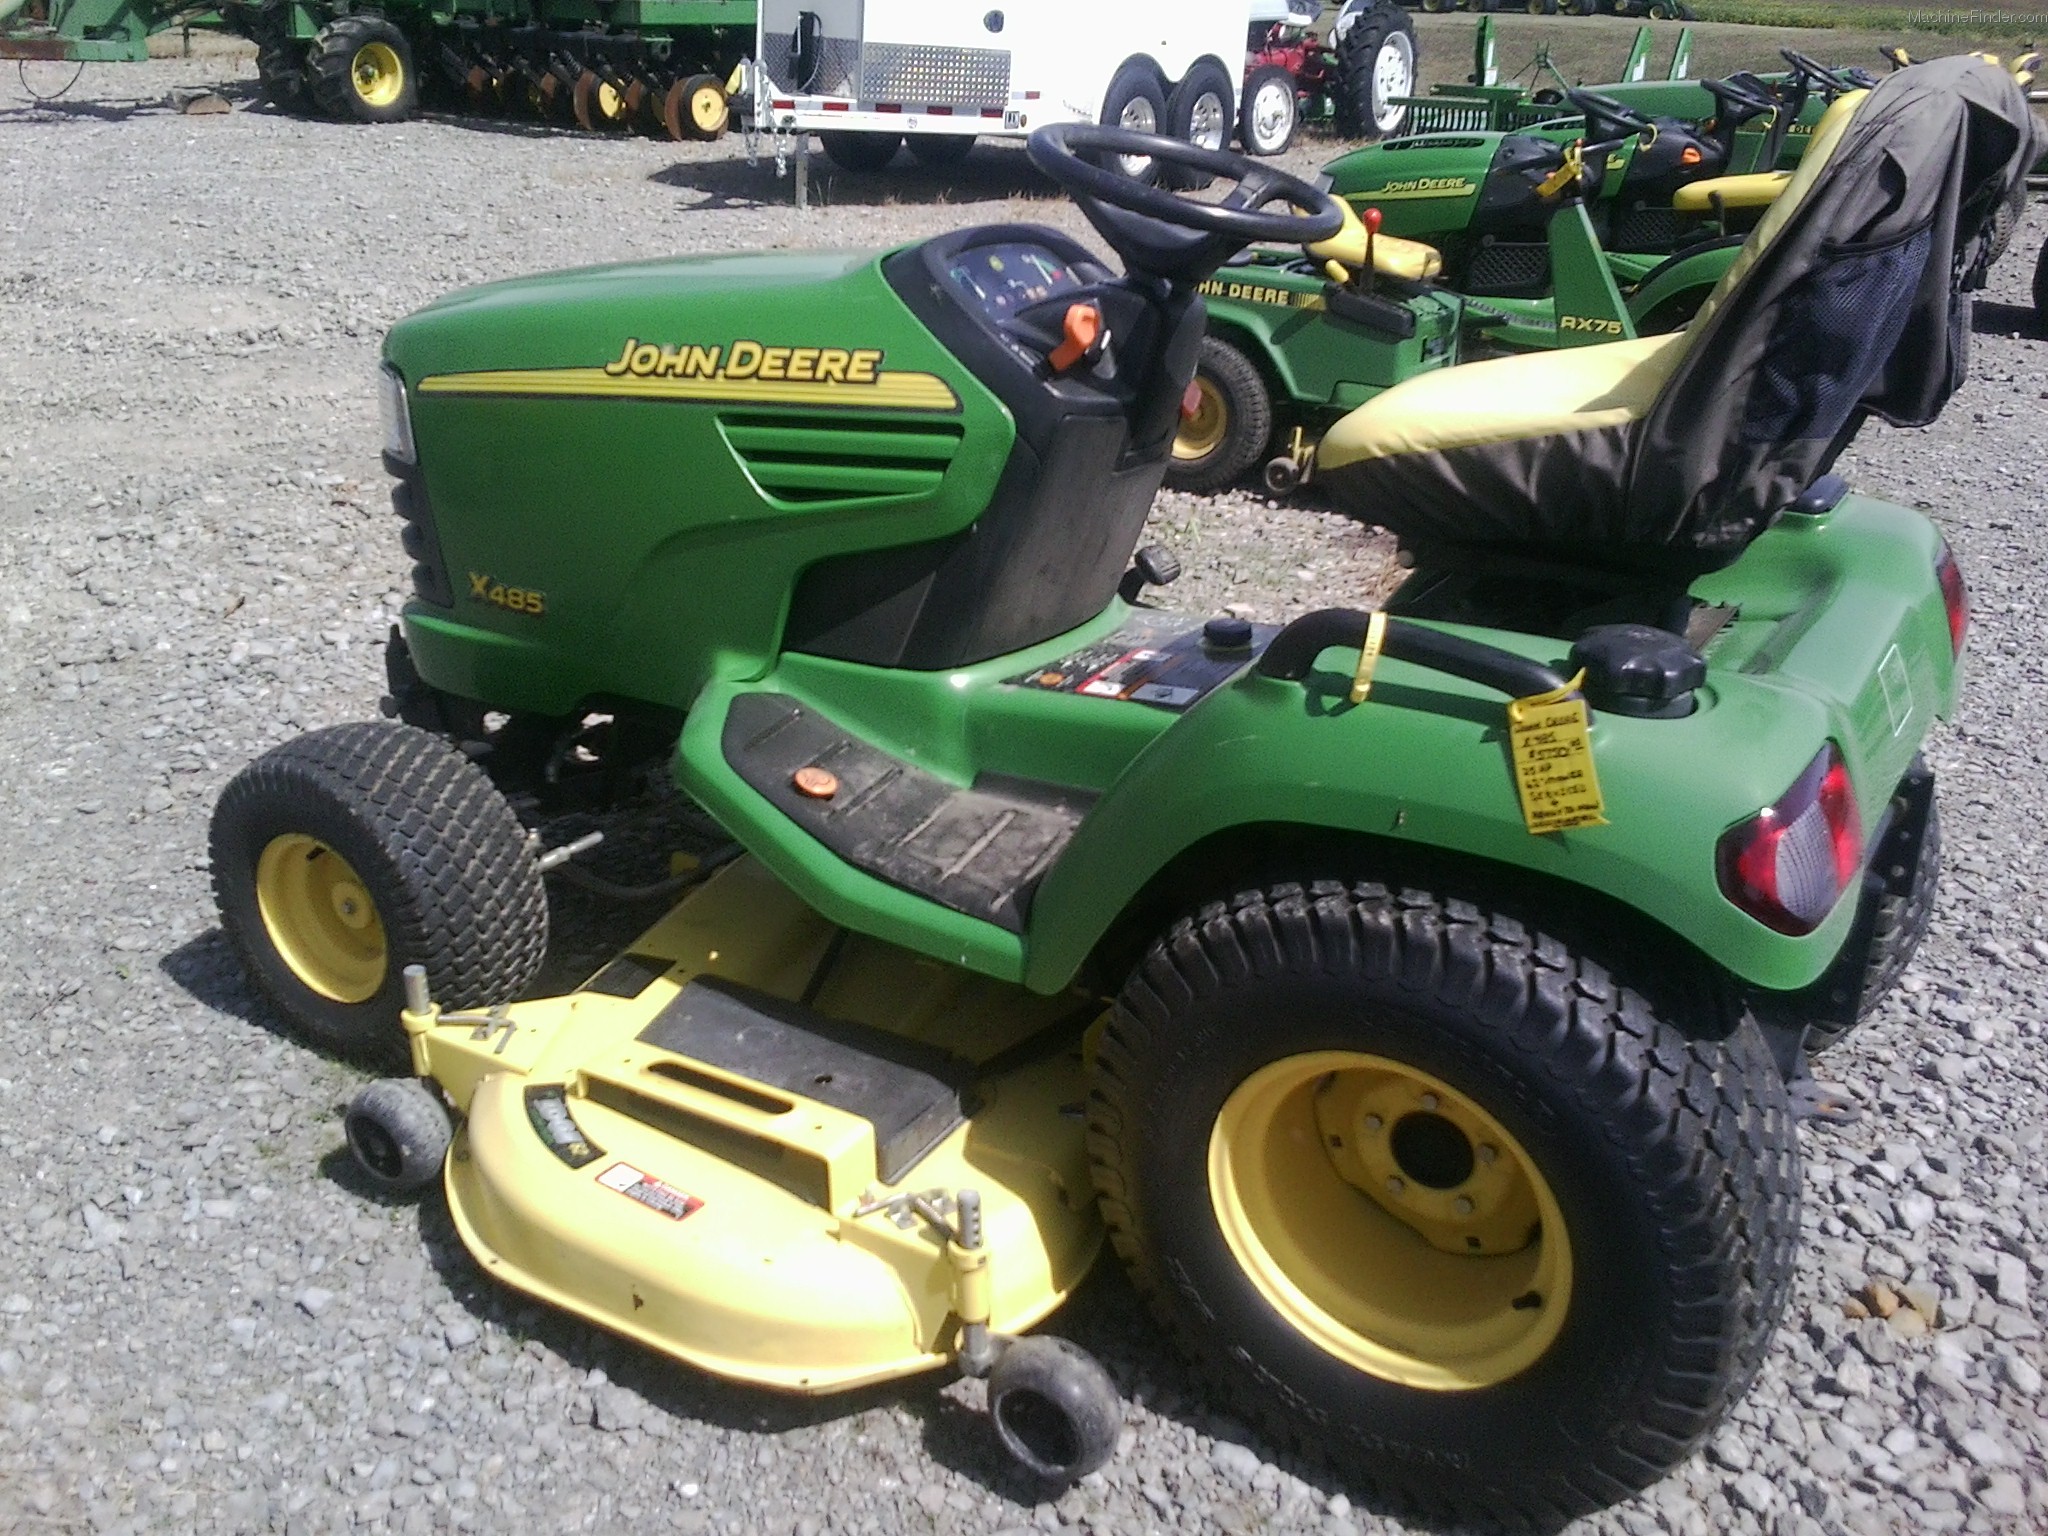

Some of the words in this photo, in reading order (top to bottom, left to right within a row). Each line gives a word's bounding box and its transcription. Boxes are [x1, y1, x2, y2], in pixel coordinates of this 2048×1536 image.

[1381, 181, 1418, 194] JOHN
[1417, 177, 1467, 191] DEERE
[1193, 279, 1224, 296] HN
[1228, 283, 1290, 306] DEERE
[1560, 315, 1622, 335] RX75
[605, 337, 722, 378] JOHN
[724, 339, 884, 384] DEERE
[466, 570, 544, 614] X485
